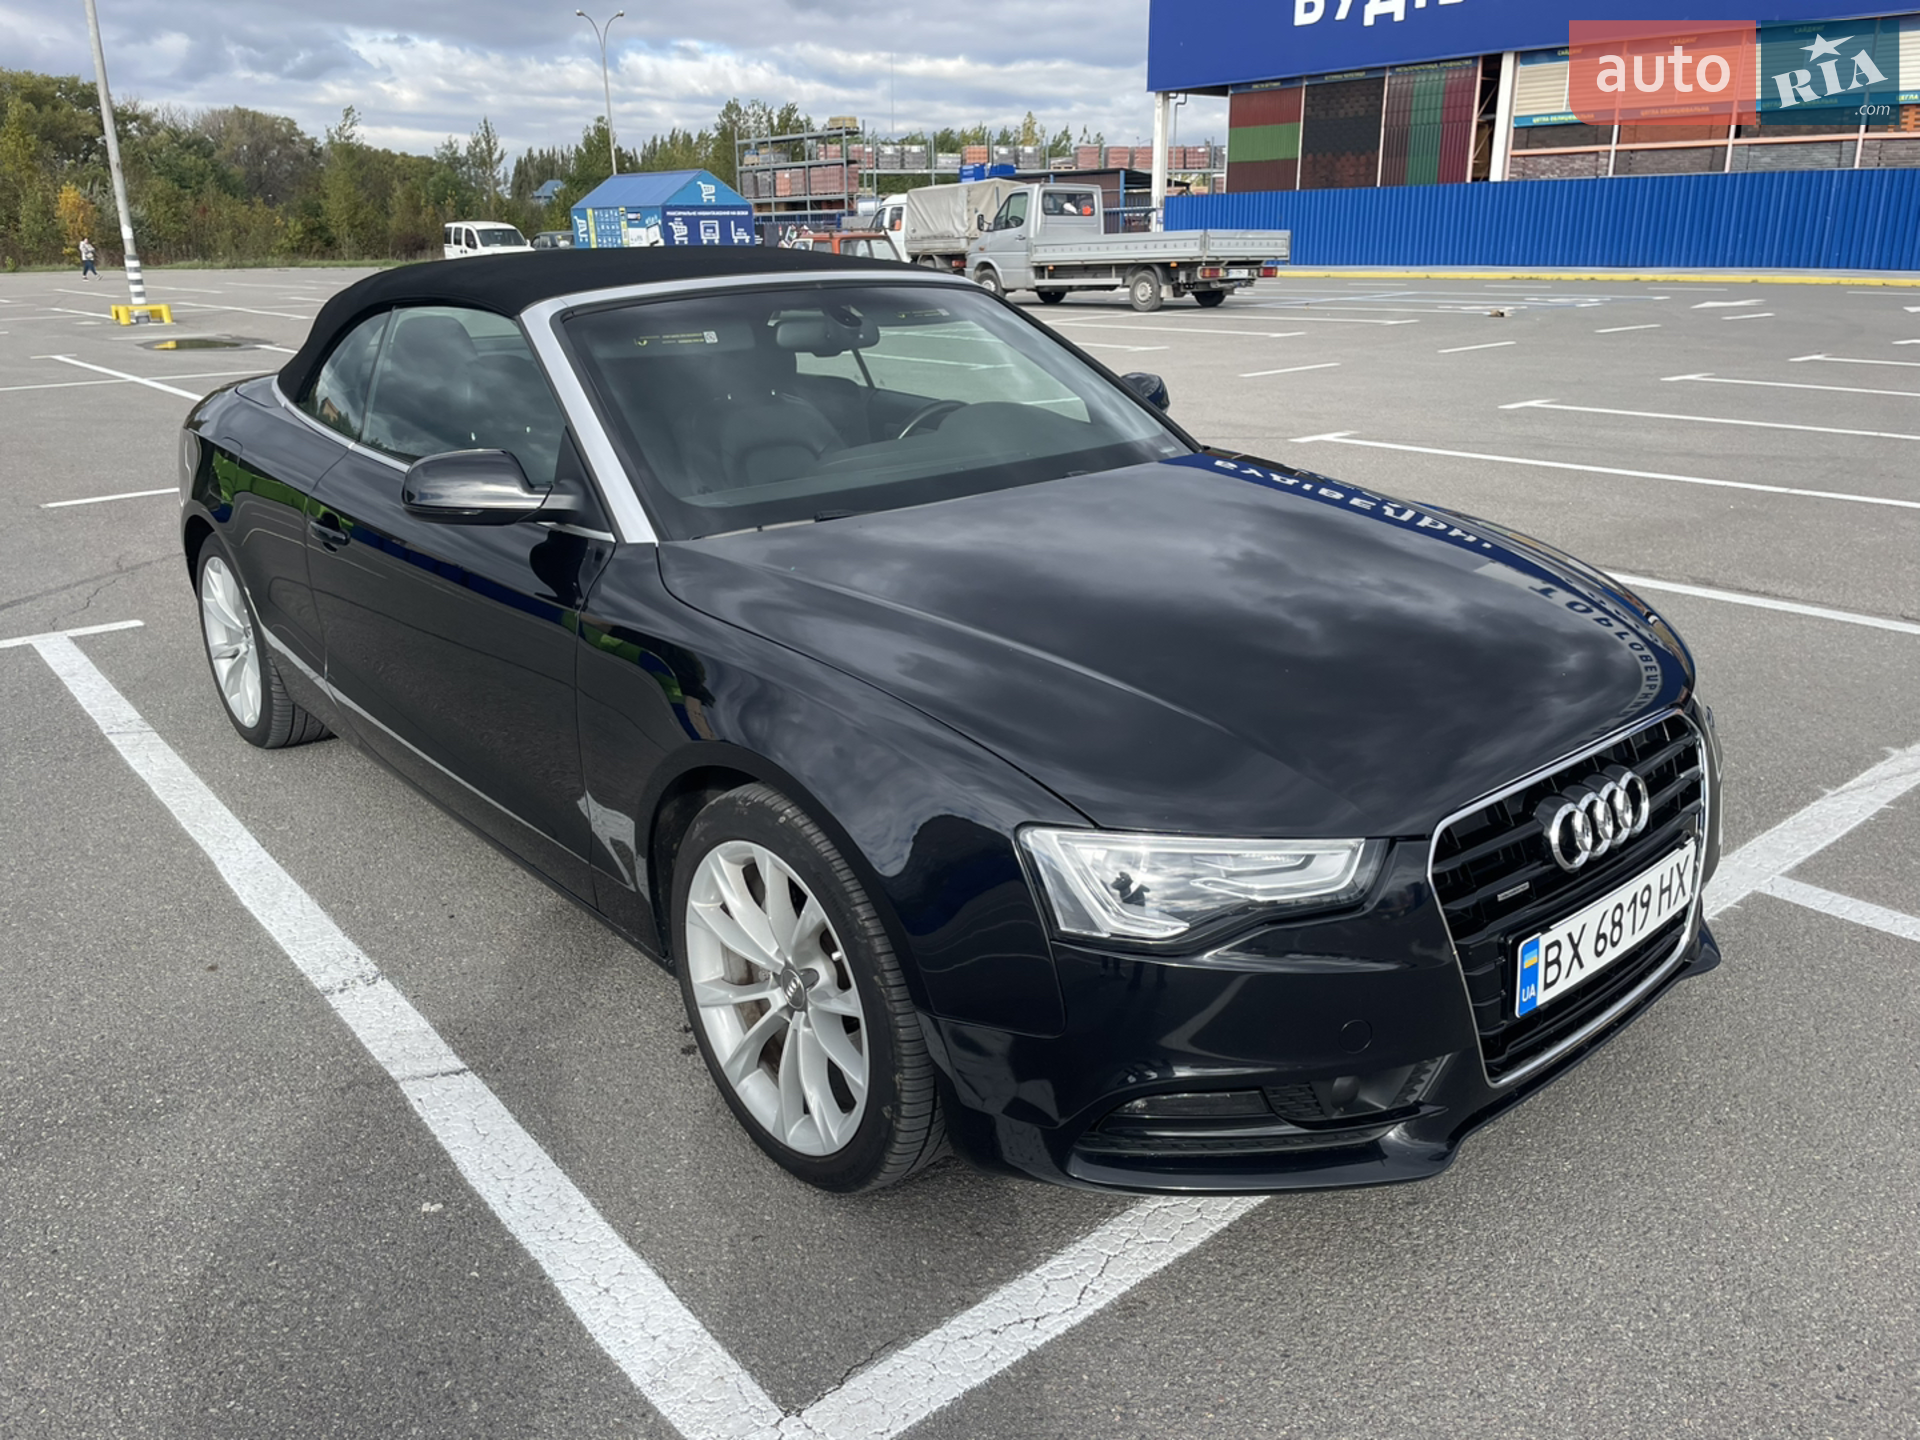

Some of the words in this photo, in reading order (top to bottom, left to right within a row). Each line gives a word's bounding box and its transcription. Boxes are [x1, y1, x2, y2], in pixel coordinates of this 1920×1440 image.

[1543, 923, 1587, 992] BX
[1594, 884, 1652, 958] 6819
[1657, 854, 1690, 918] HX
[1522, 984, 1537, 1003] UA
